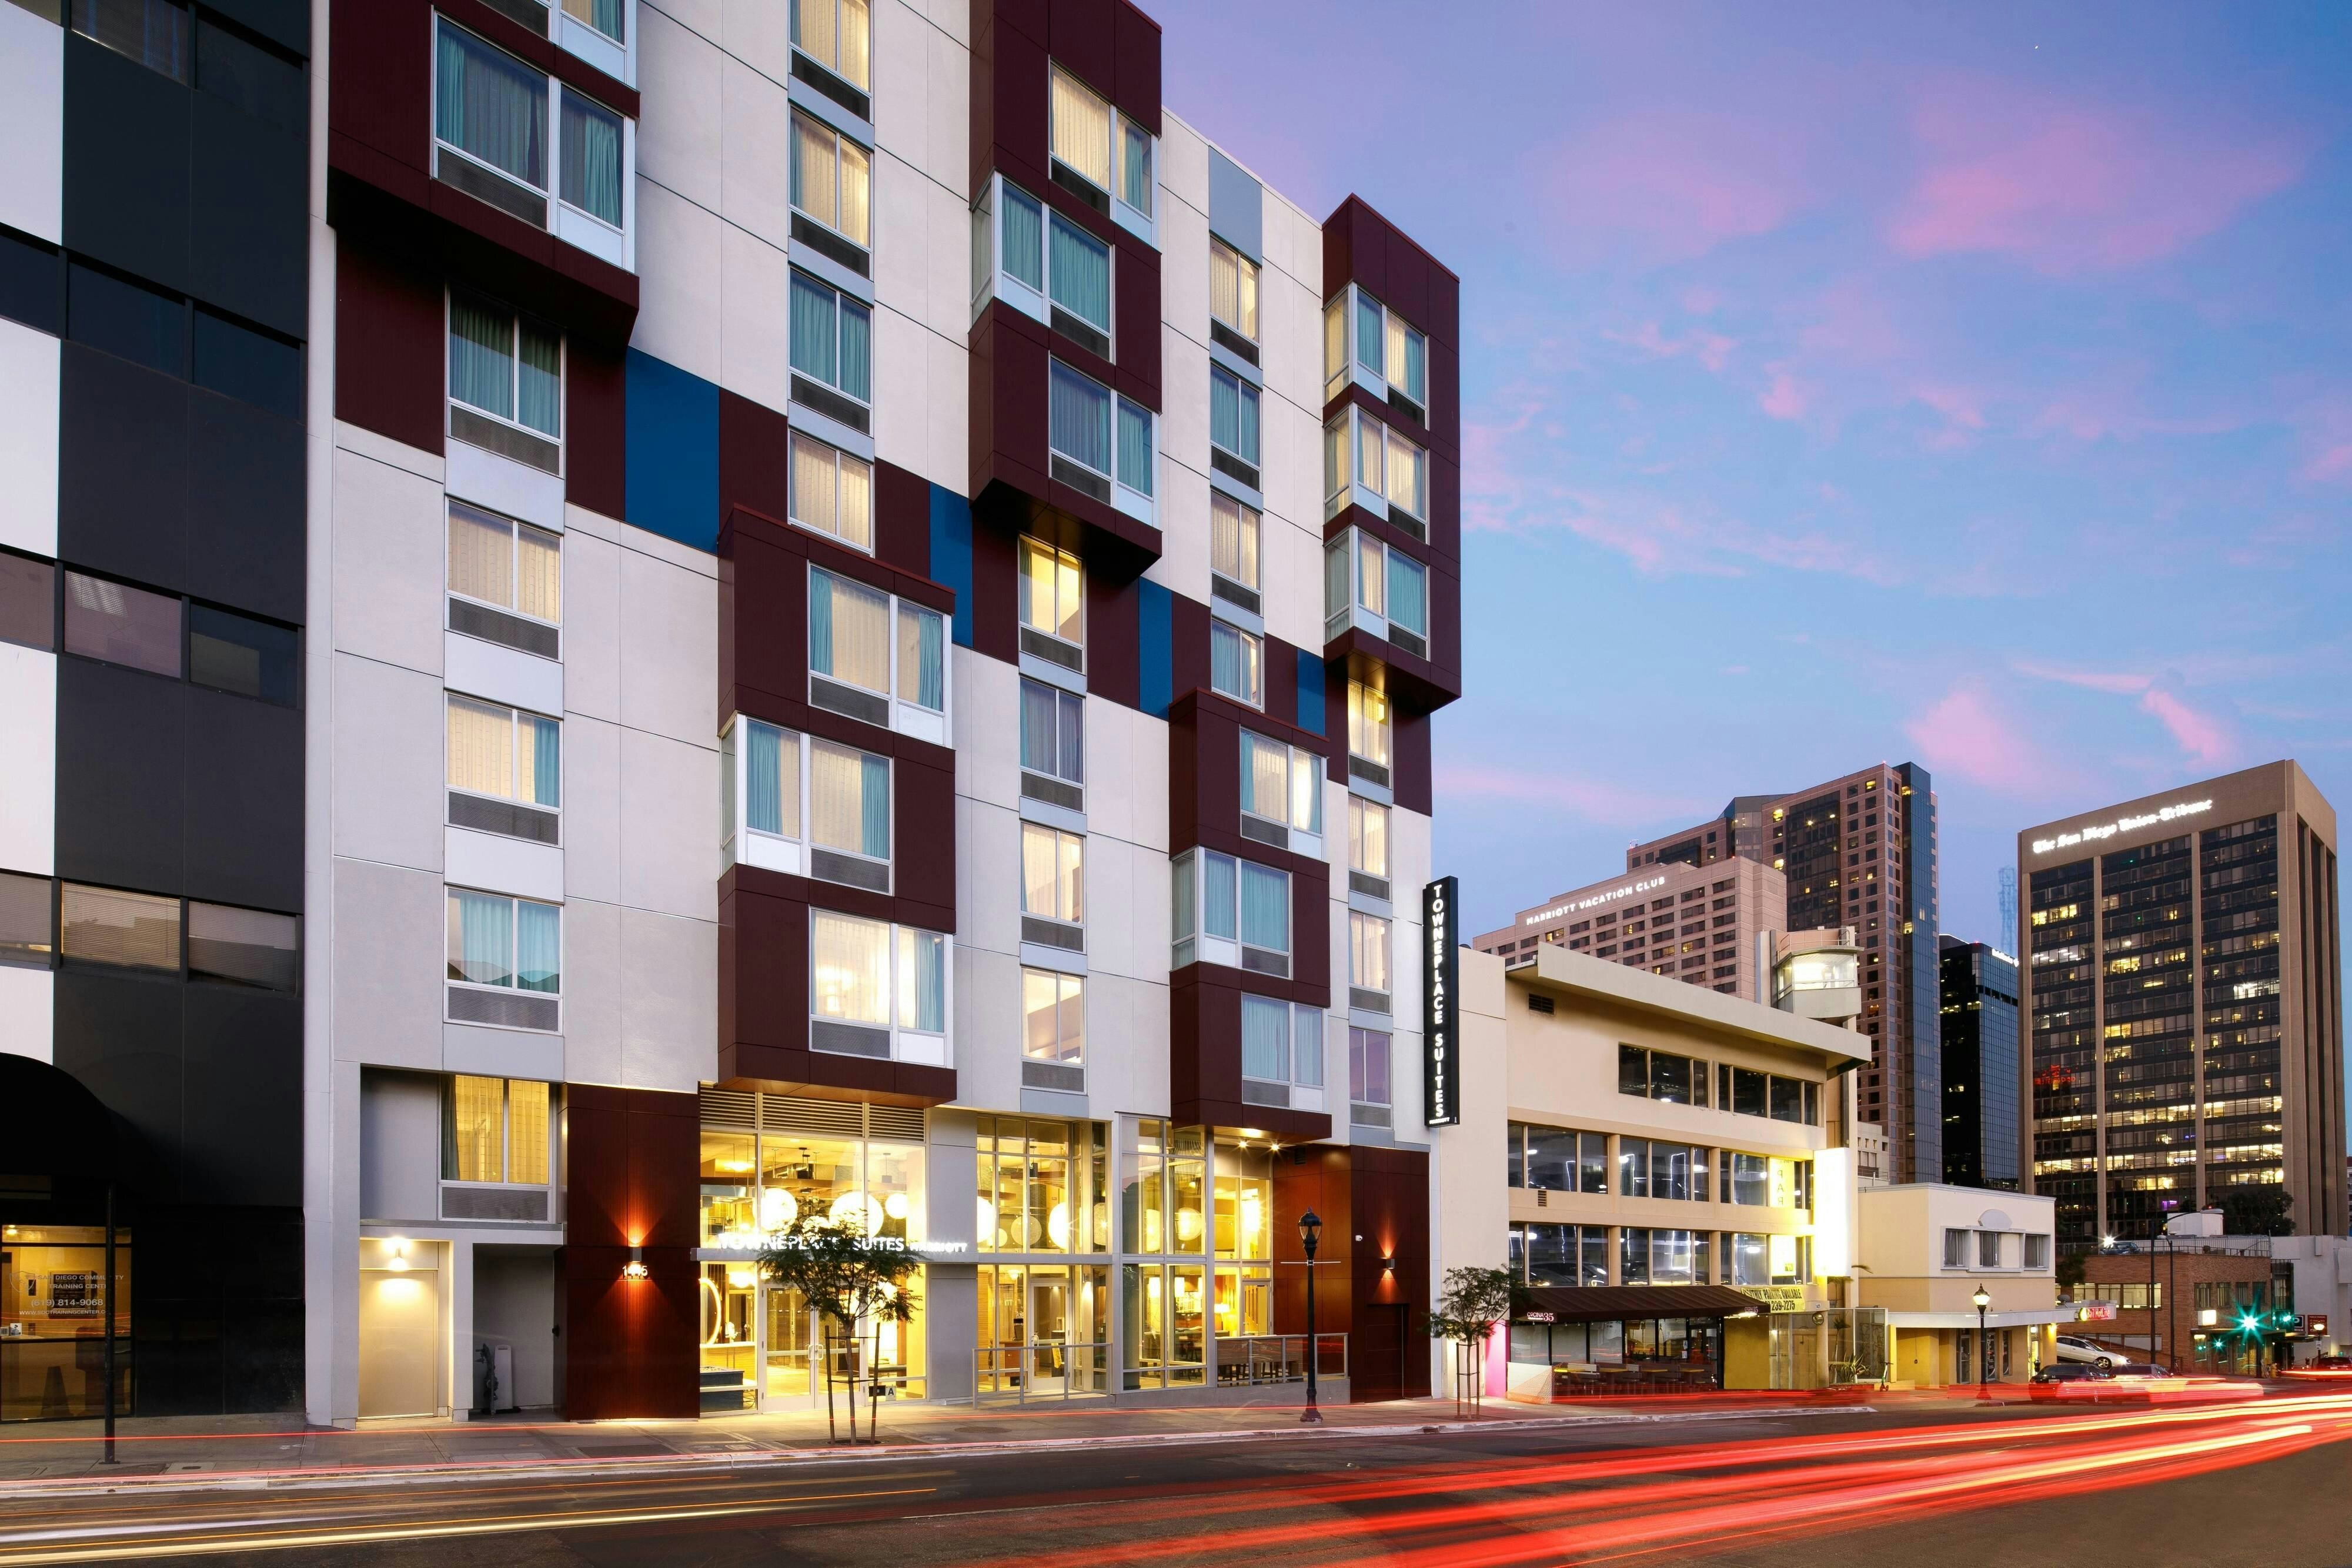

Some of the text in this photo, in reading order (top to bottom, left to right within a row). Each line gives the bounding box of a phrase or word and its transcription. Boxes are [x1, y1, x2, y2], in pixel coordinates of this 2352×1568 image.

[2033, 839, 2056, 854] The
[1526, 876, 1665, 925] MARRIOTT VACATION CLUB
[1432, 884, 1444, 1118] TOWNEPLACE SUITES
[718, 1234, 841, 1250] TOWNEPLA
[853, 1236, 904, 1252] SUITES
[1781, 1288, 1802, 1299] AVAILABLE
[31, 1299, 55, 1308] (619)
[1771, 1300, 1795, 1311] 239-7275
[1543, 1312, 1554, 1322] 35
